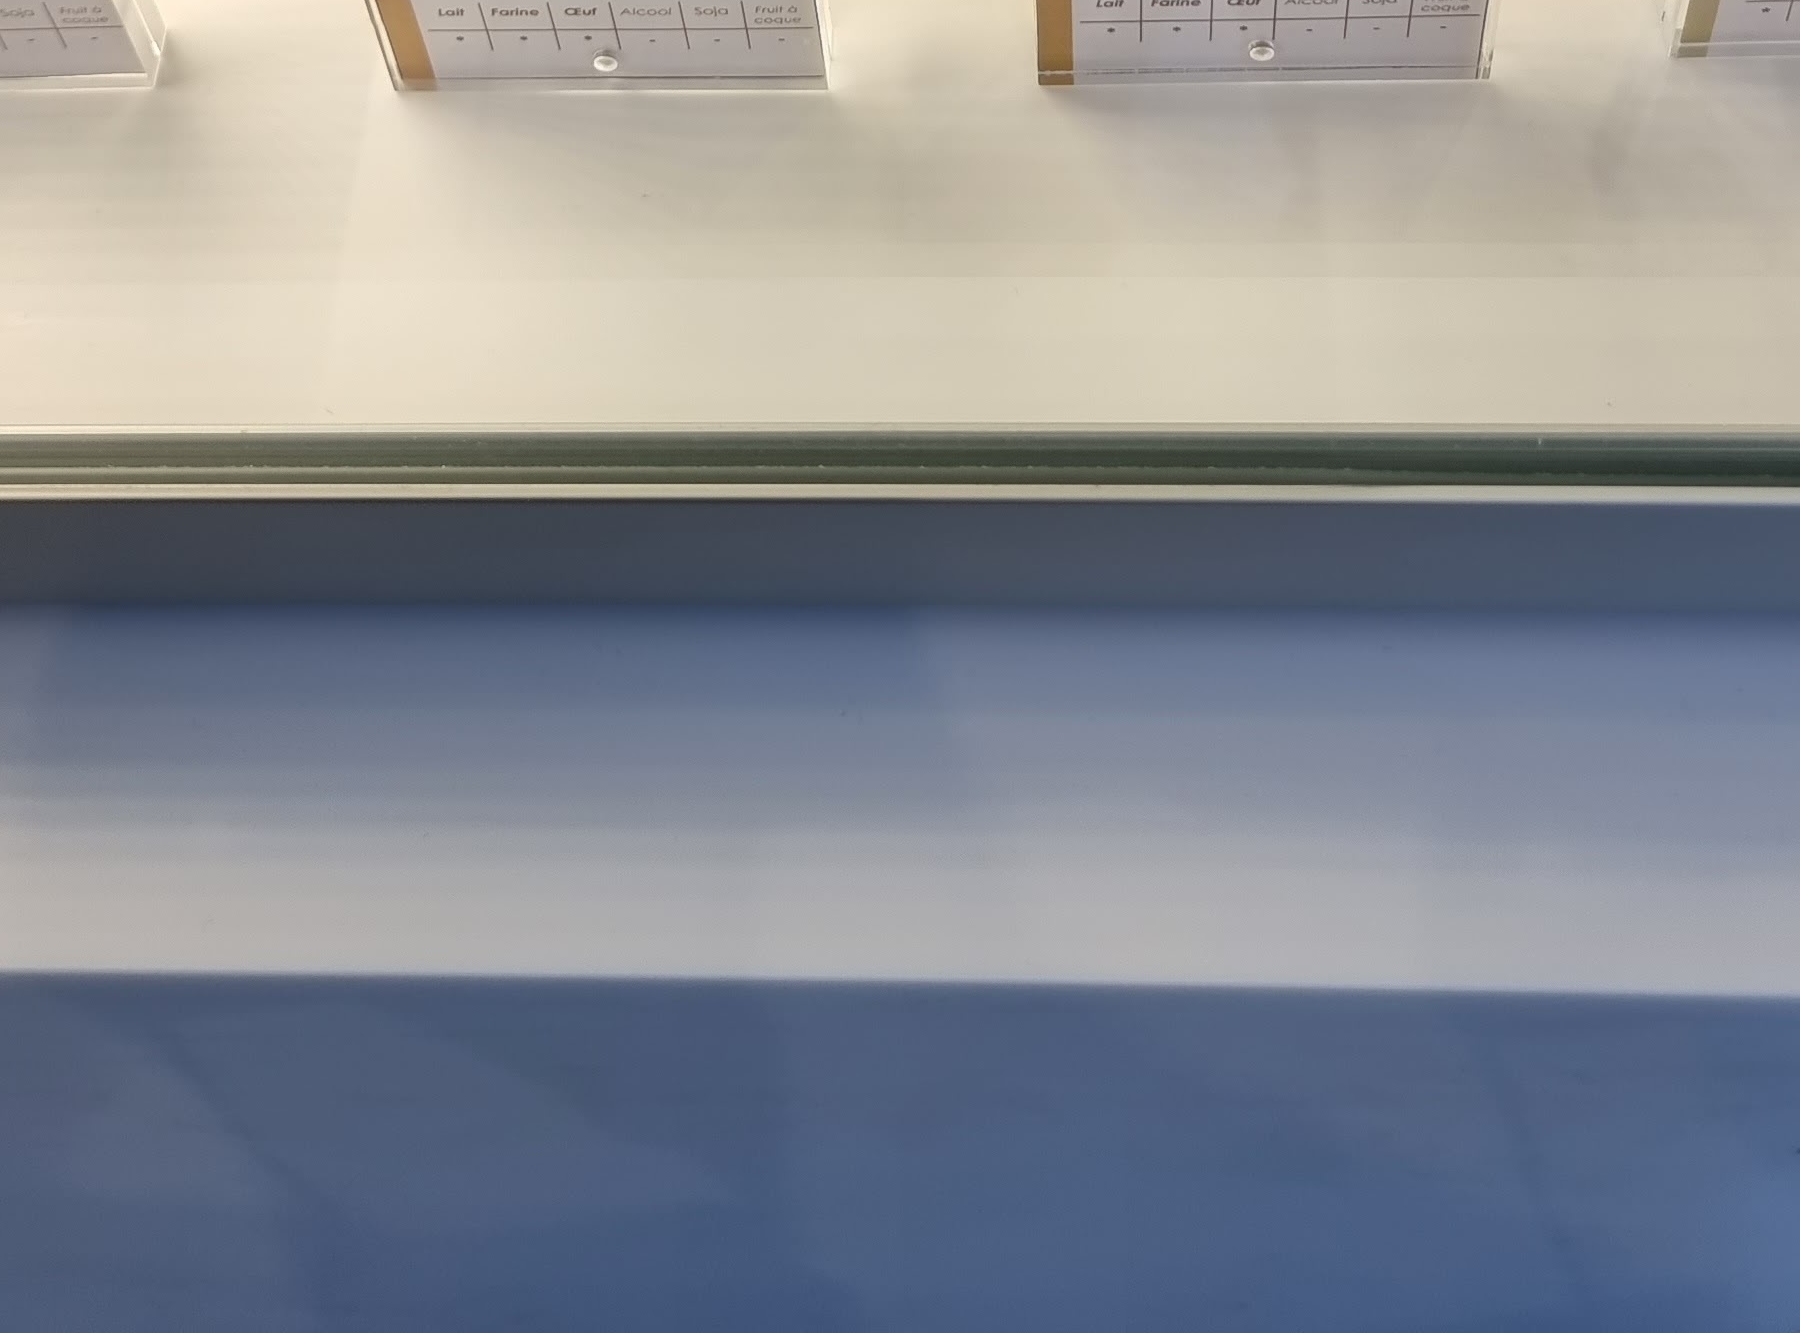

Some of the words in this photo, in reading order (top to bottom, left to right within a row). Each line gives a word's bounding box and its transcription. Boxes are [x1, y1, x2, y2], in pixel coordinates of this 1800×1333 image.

[437, 7, 466, 17] Lait
[490, 7, 540, 17] Farine
[563, 7, 598, 17] Œuf
[619, 6, 673, 17] Alcool
[693, 5, 730, 17] Soja
[754, 4, 784, 14] Fruit
[1420, 3, 1471, 12] coque
[753, 15, 802, 25] coque
